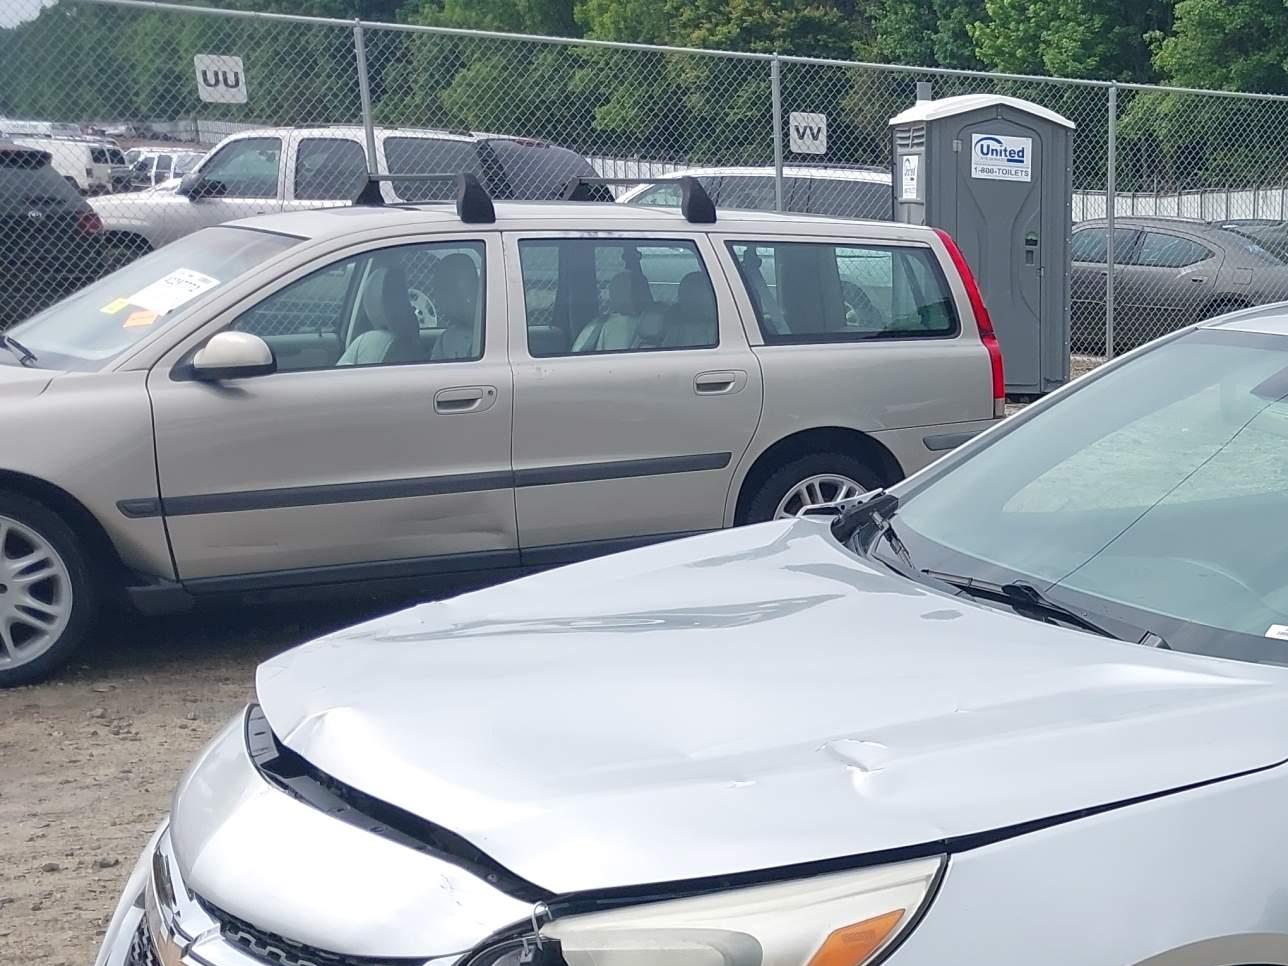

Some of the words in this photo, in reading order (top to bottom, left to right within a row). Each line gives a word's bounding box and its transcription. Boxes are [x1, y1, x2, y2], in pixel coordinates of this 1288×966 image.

[201, 69, 240, 88] UU
[794, 124, 822, 141] VV
[980, 143, 1025, 159] United
[974, 166, 1030, 177] 1-800-TOILETS
